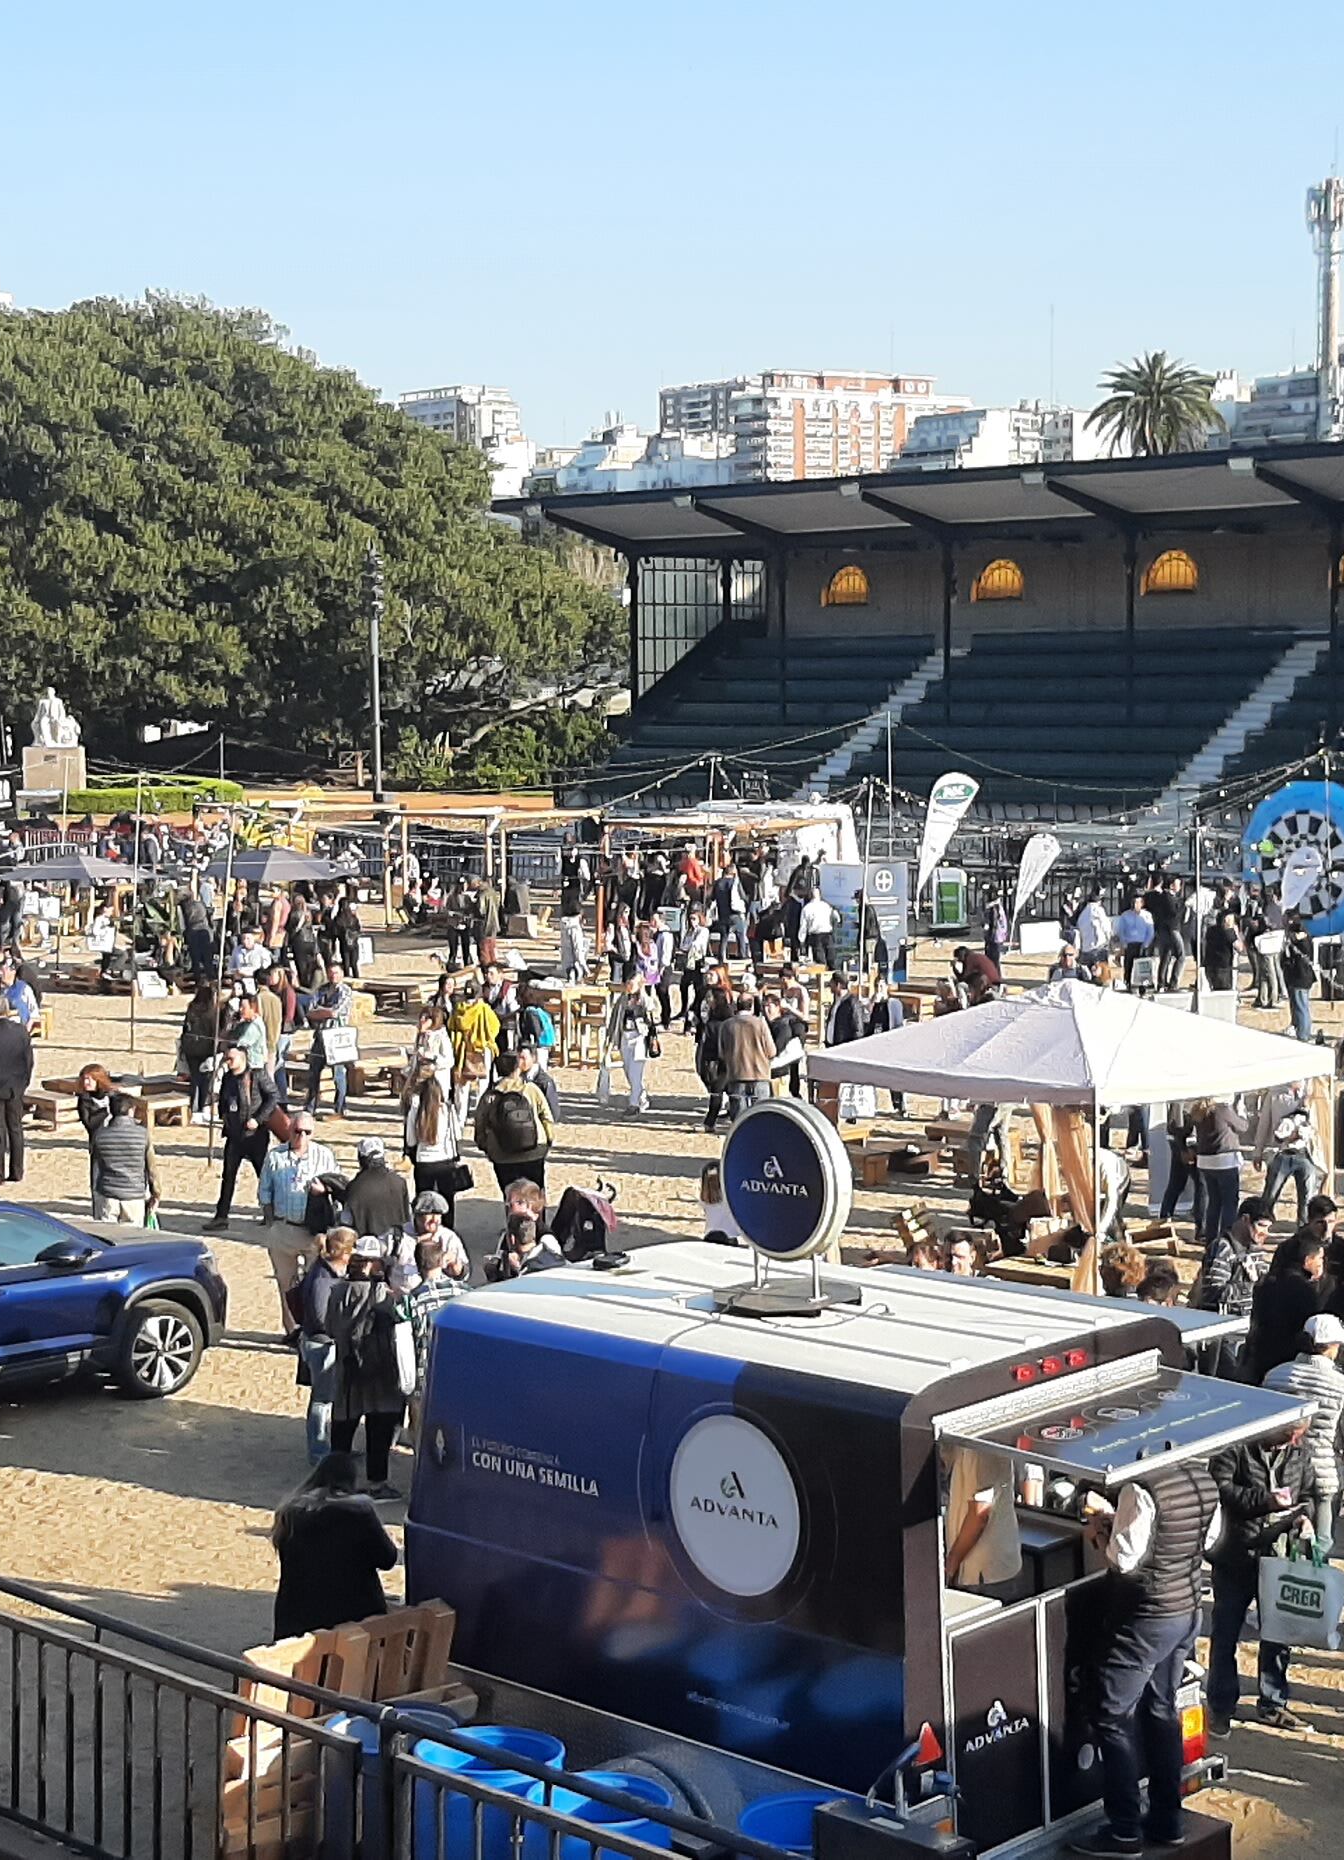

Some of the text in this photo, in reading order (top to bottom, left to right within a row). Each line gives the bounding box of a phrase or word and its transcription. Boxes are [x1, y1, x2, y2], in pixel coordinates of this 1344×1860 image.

[740, 1180, 809, 1198] ADVANTA
[472, 1451, 502, 1472] CON
[506, 1459, 536, 1481] UNA
[539, 1466, 600, 1498] SEMILLA
[690, 1496, 778, 1529] ADVANTA
[1280, 1584, 1321, 1609] CREA
[964, 1717, 1030, 1753] ADVANTA
